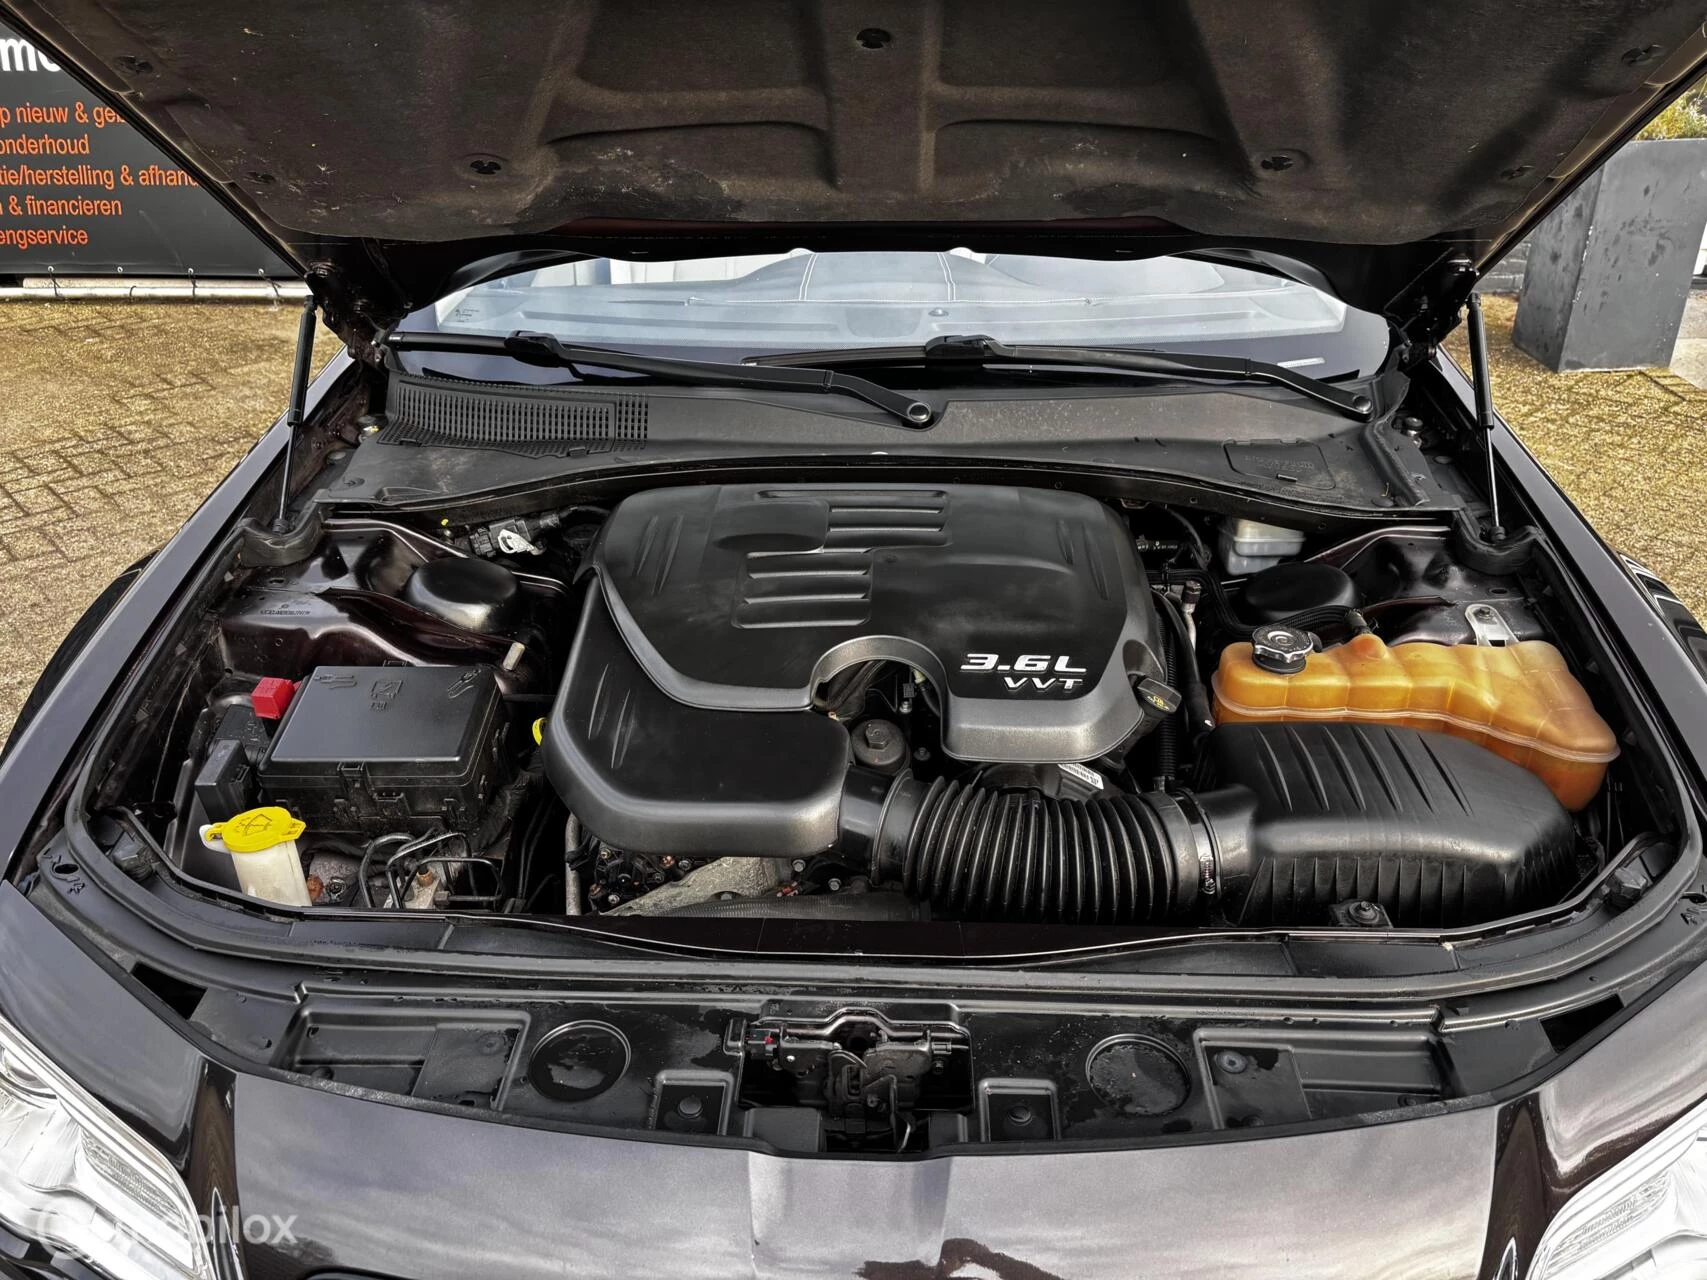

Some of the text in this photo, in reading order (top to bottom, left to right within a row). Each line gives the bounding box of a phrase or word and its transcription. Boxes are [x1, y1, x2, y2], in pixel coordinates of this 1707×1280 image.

[15, 102, 68, 123] nieuw
[75, 101, 89, 123] &
[120, 164, 134, 186] &
[8, 195, 23, 215] &
[25, 195, 122, 215] financieren
[960, 653, 1087, 673] 3.6L
[1003, 676, 1084, 691] VVT
